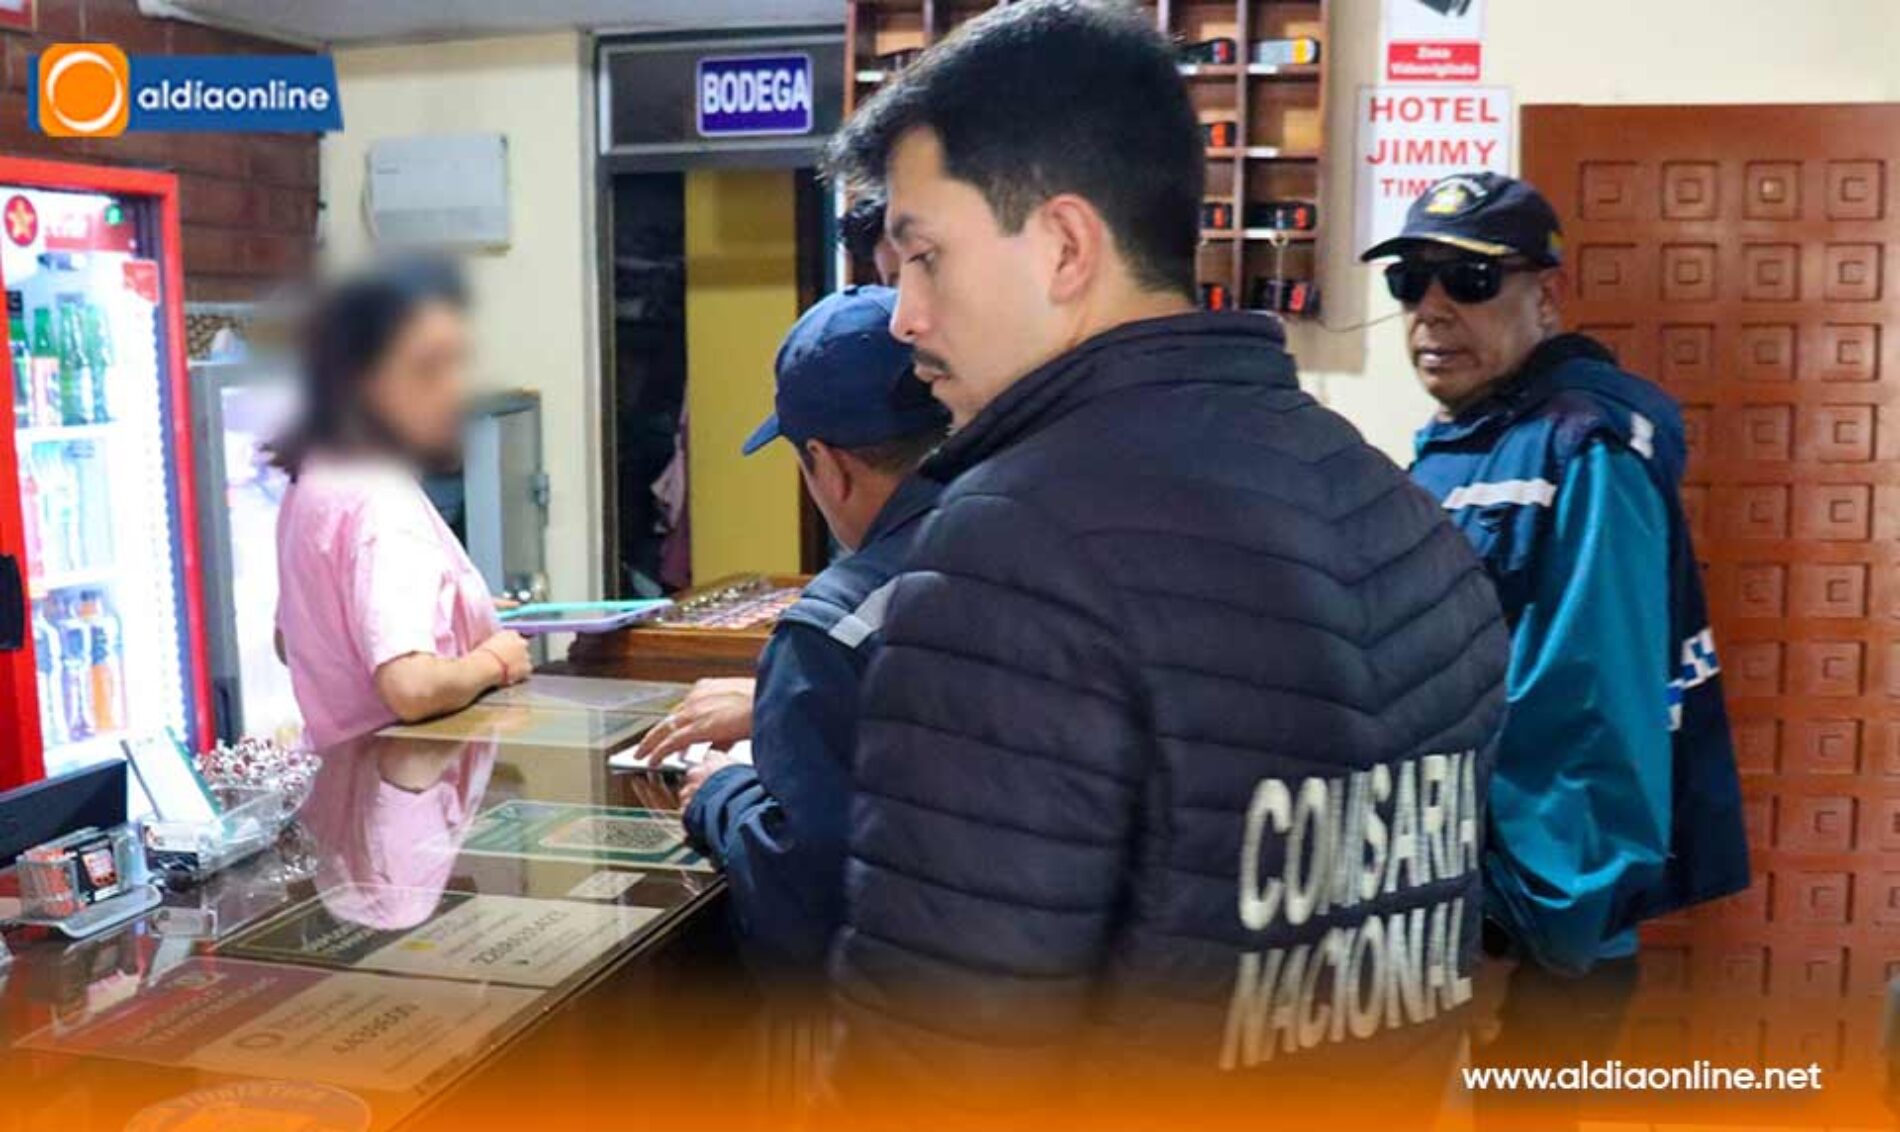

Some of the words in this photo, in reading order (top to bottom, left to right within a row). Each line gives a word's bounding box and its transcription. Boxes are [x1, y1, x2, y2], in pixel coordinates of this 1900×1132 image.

[703, 68, 810, 114] BODEGA
[1369, 96, 1499, 123] HOTEL
[1366, 139, 1497, 165] JIMMY
[1380, 178, 1439, 198] TIM
[1218, 898, 1473, 1070] NACIONAL
